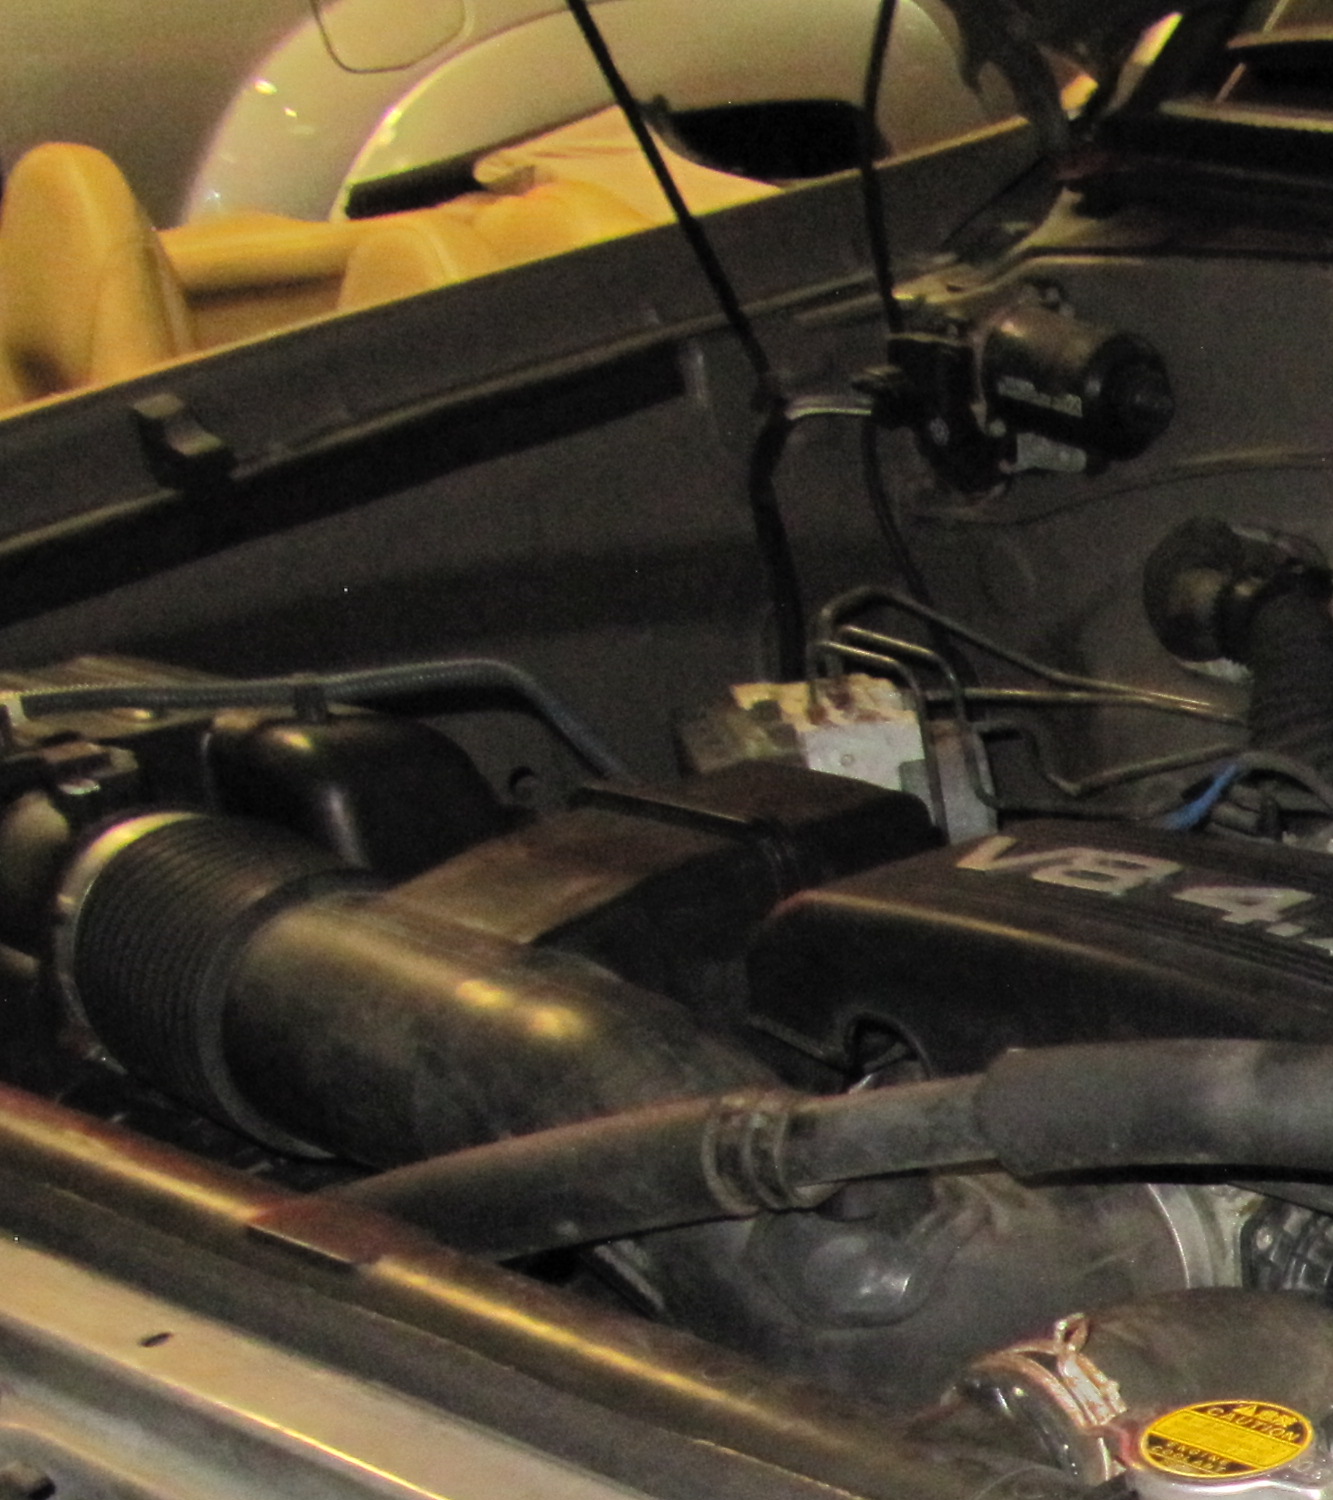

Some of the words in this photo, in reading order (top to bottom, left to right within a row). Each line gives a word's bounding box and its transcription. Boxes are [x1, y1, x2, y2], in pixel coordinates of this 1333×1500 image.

[957, 836, 1186, 896] V8
[1207, 1407, 1301, 1442] CAUTION
[1166, 1440, 1230, 1466] ENGINE
